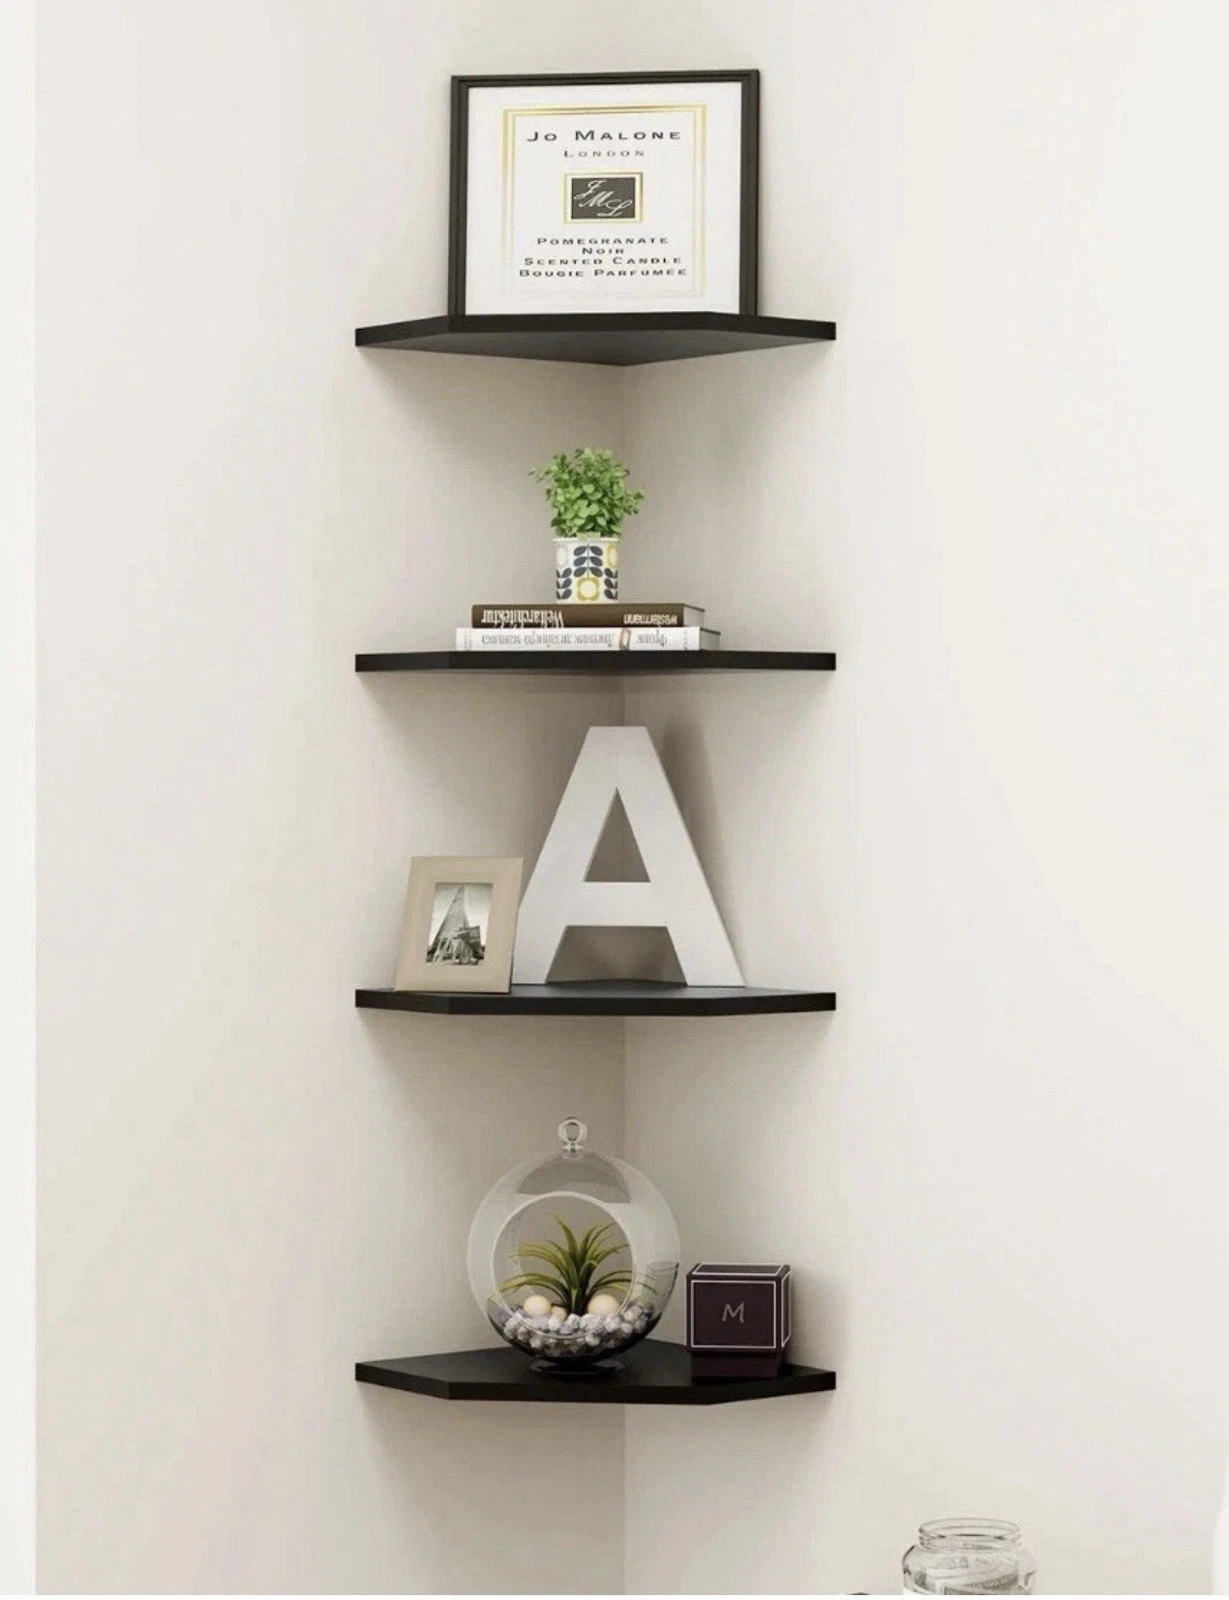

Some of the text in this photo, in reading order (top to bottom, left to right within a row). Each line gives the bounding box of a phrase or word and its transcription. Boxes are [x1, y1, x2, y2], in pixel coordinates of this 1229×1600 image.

[575, 130, 681, 141] MALONE
[564, 150, 644, 158] LONDON
[537, 237, 669, 245] POMEGRANATE
[582, 247, 624, 255] NOIR
[524, 256, 682, 266] SCENTED CANDLE
[519, 269, 584, 278] BOUGIE
[481, 609, 564, 628] Weltarchitektur
[511, 726, 746, 987] A
[722, 1302, 746, 1323] M
